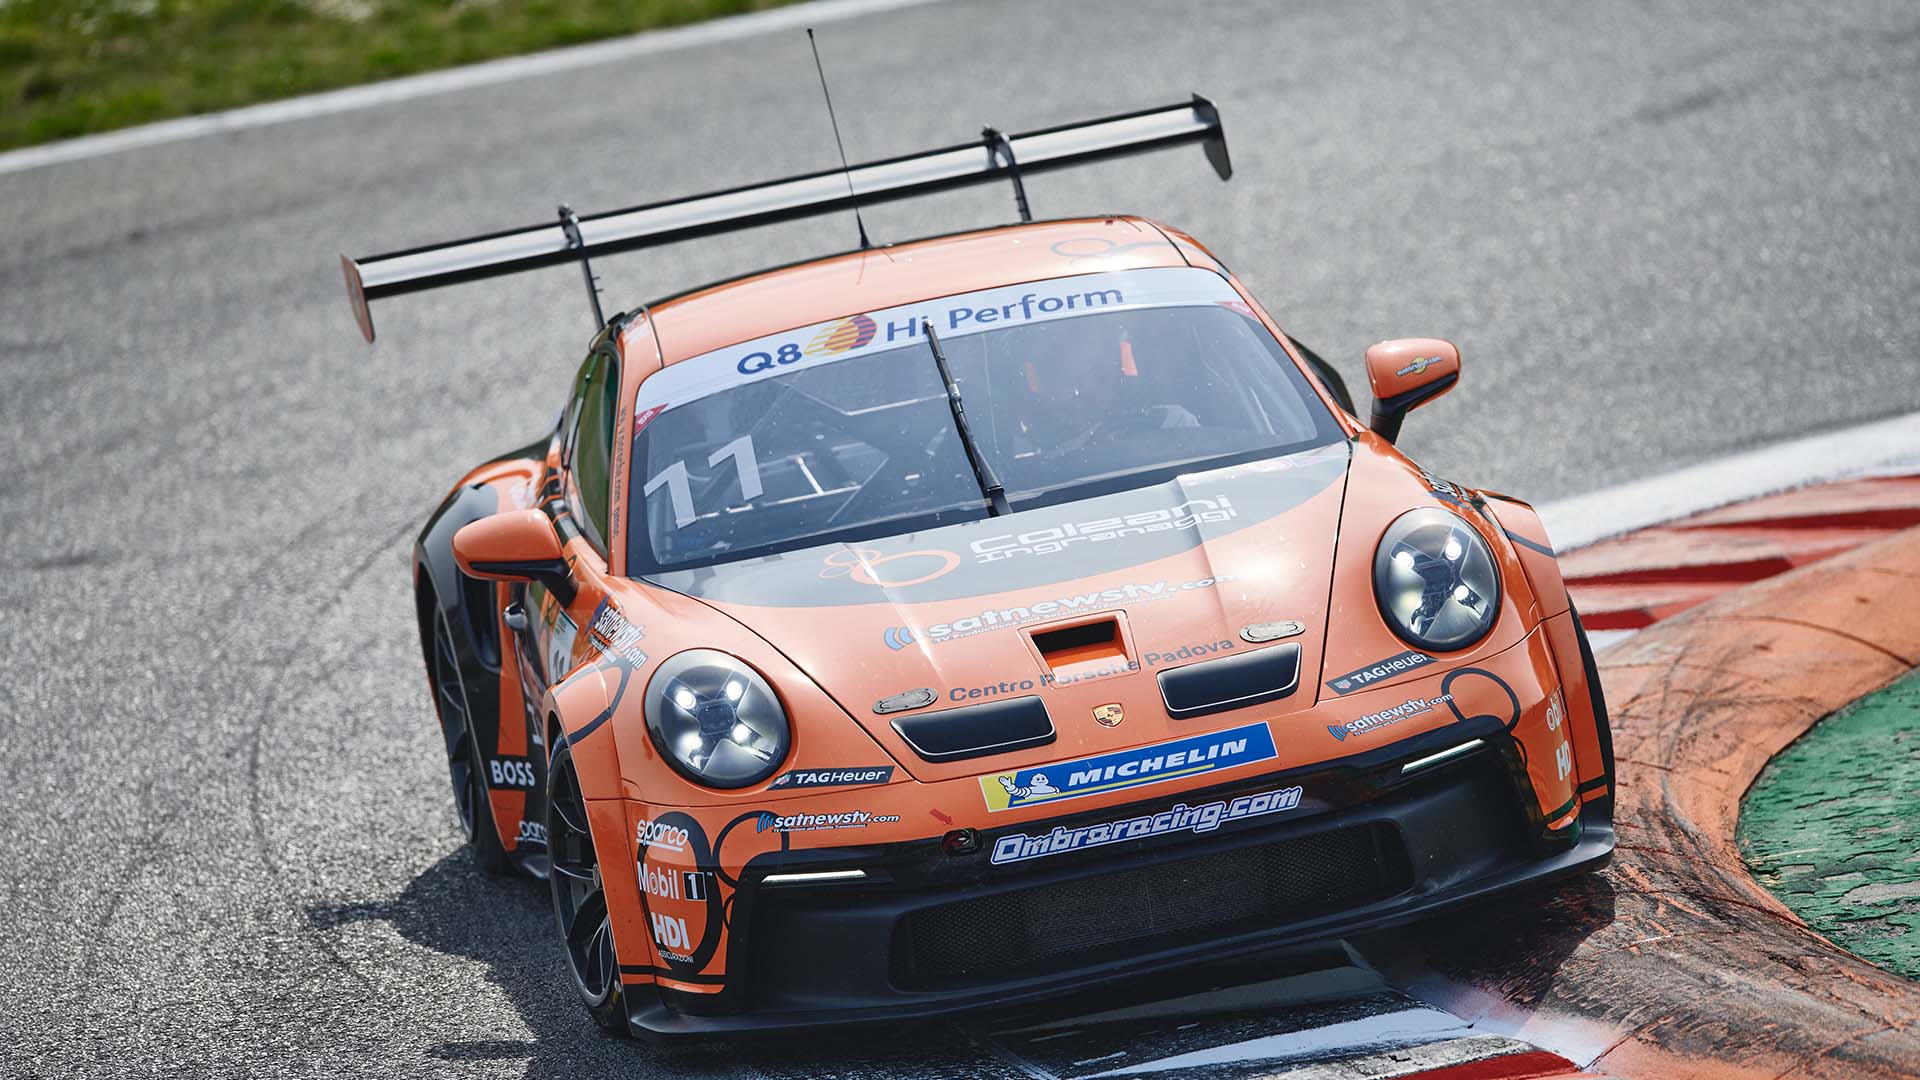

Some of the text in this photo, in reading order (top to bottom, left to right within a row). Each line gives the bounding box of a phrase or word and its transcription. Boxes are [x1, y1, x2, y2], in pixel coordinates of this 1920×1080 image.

[736, 288, 1124, 376] Q8 Hi Perform
[643, 434, 764, 529] 11
[949, 637, 1235, 702] Centro Porsche Padova
[1346, 692, 1454, 733] satnewstv.com
[490, 760, 536, 787] BOSS
[1067, 738, 1248, 787] MICHELIN
[637, 818, 689, 847] sparco
[773, 811, 900, 829] satnewstv.com
[992, 787, 1303, 864] Ombraracing.com
[637, 860, 680, 900] Mobil
[651, 911, 691, 951] HDI
